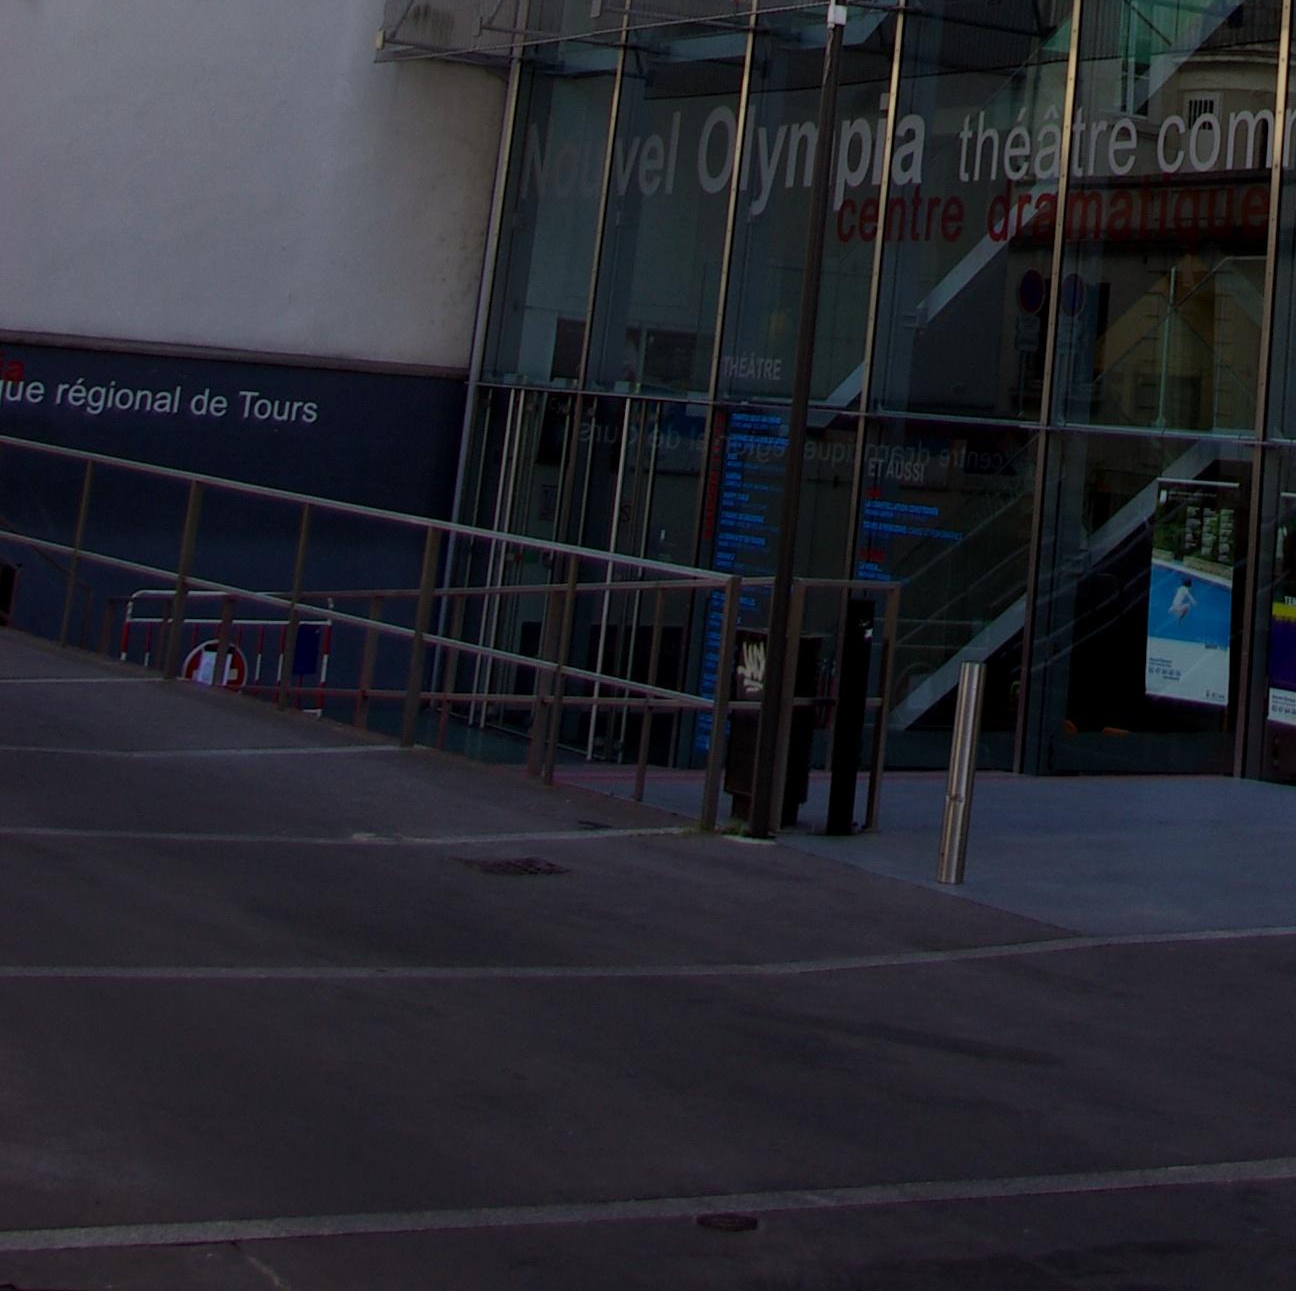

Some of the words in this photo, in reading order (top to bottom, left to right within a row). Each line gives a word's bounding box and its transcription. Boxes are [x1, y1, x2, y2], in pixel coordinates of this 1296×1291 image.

[699, 92, 926, 218] Olympia
[957, 105, 1137, 183] théâtre
[837, 185, 964, 242] centre
[987, 171, 1269, 254] dramatique
[721, 352, 782, 380] THÉÂTRE
[55, 378, 182, 415] régional
[190, 388, 229, 417] de
[238, 390, 320, 424] Tours
[886, 460, 926, 483] AUSSI
